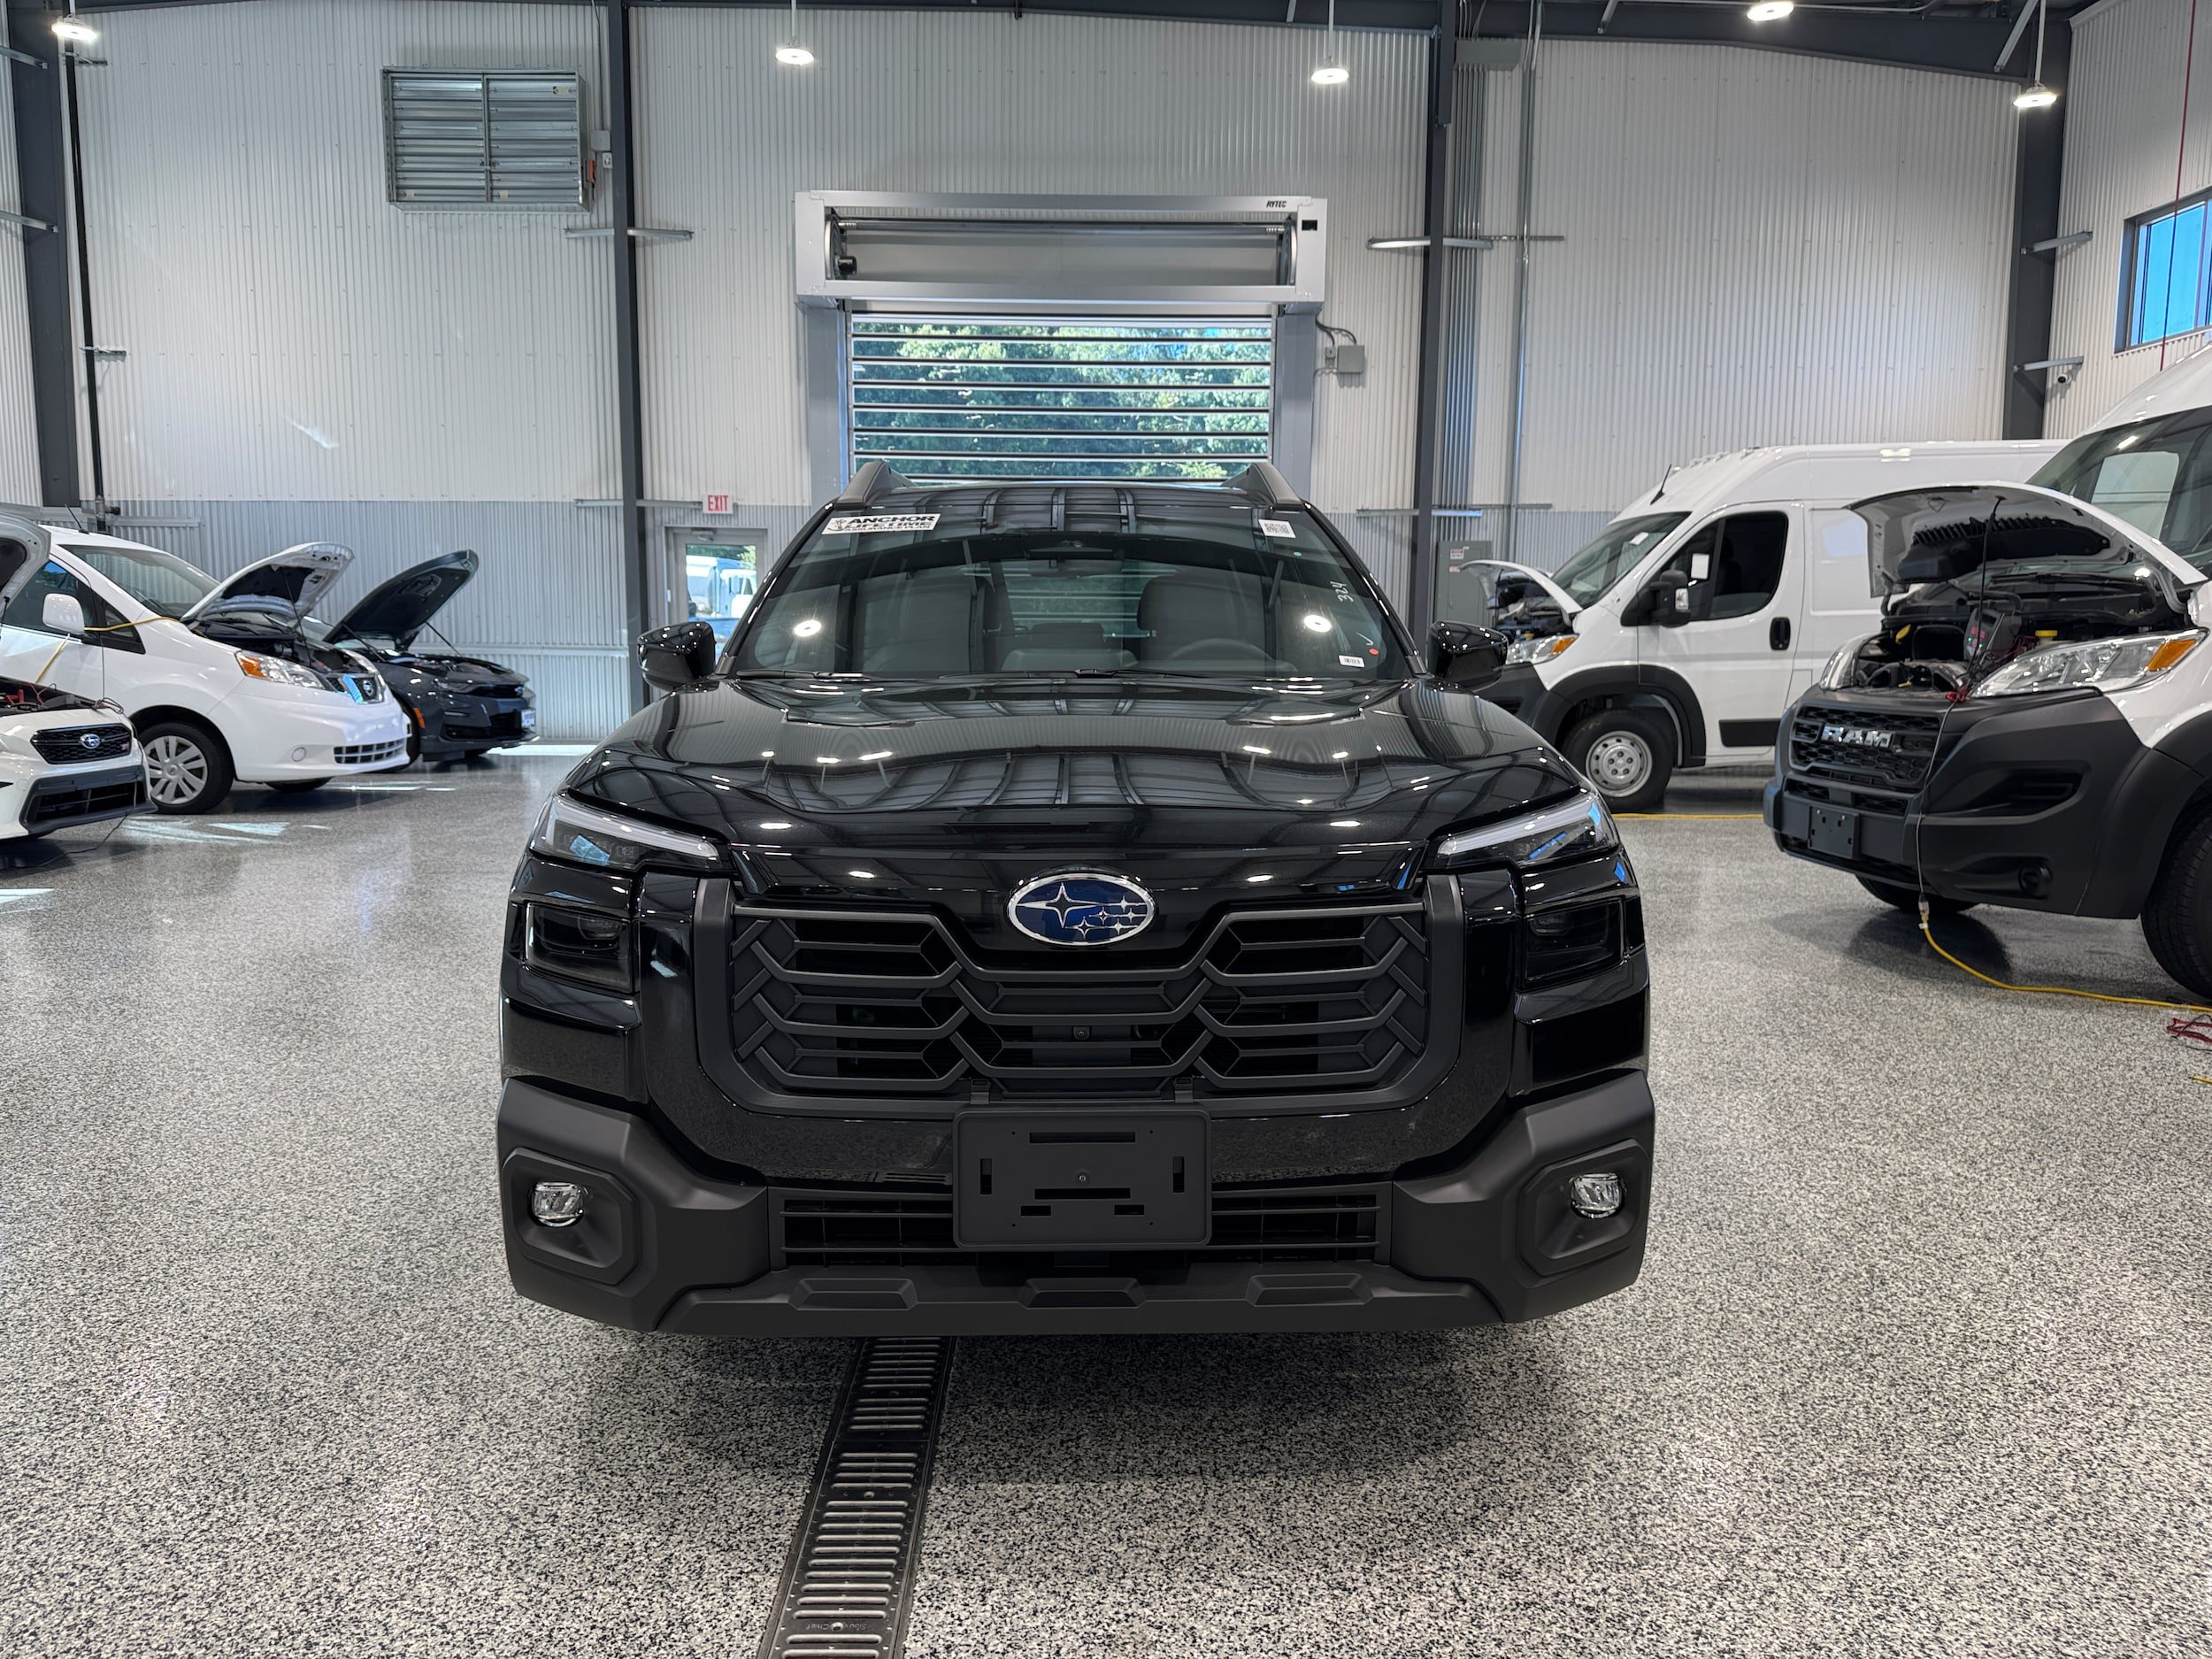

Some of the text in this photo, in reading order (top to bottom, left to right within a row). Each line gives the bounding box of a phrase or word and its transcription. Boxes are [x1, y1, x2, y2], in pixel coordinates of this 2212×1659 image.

[707, 495, 728, 511] EXIT
[849, 515, 935, 525] ANCHOR
[1330, 580, 1354, 603] 324
[1821, 725, 1894, 749] RAM
